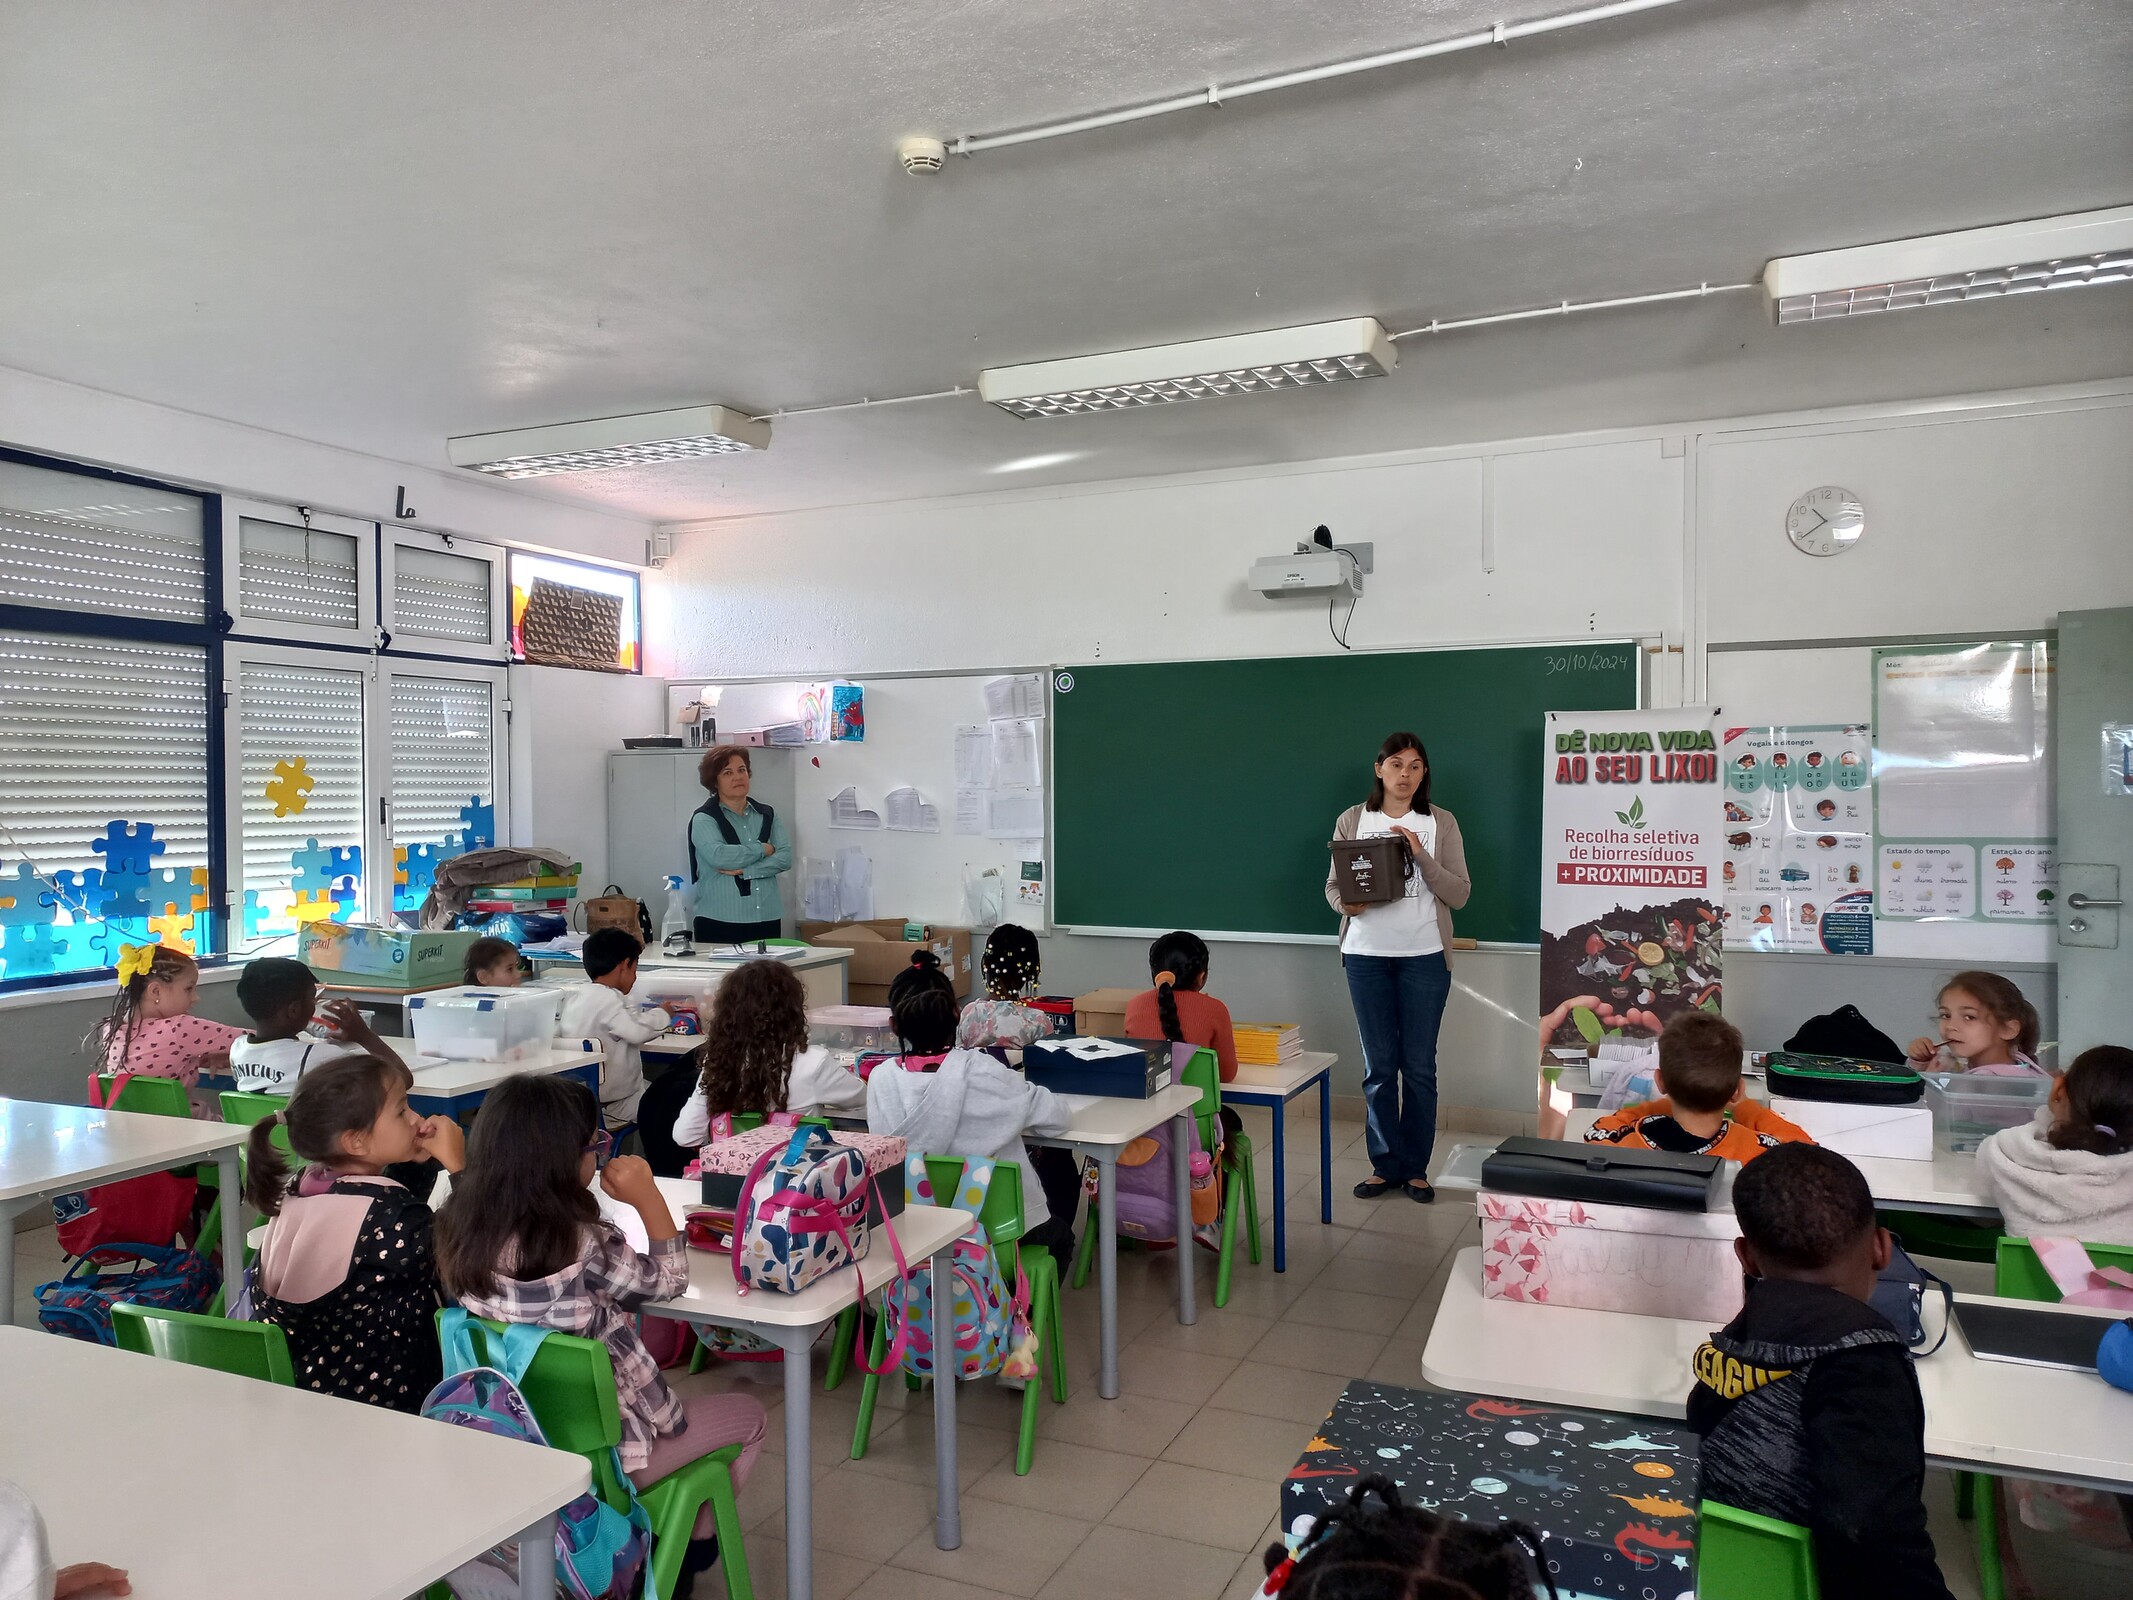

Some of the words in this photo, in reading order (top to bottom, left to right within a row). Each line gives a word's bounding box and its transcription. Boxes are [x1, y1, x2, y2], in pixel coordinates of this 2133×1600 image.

[1807, 495, 1816, 504] 11
[1820, 489, 1832, 500] 12
[1796, 505, 1807, 515] 10
[1808, 540, 1815, 550] 7
[1821, 543, 1830, 553] 6
[1544, 650, 1628, 675] 30/10/2024
[1555, 730, 1585, 752] DÊ
[1590, 732, 1652, 752] NOVA
[1658, 730, 1715, 750] VIDA
[1555, 756, 1587, 783] AO
[1595, 755, 1641, 783] SEU
[1650, 753, 1716, 782] LIXO!
[1565, 828, 1629, 844] Recolha
[1633, 829, 1699, 845] seletiva
[1569, 846, 1588, 860] de
[1592, 847, 1694, 862] biorresíduos
[1925, 848, 1951, 856] tempo
[1575, 866, 1702, 885] PROXIMIDADE
[488, 918, 510, 937] MÃOS
[304, 937, 331, 952] SUPERKIT
[417, 944, 443, 962] SUPERKIT
[232, 1063, 285, 1084] INICIUS
[1693, 1341, 1792, 1400] LEAG
